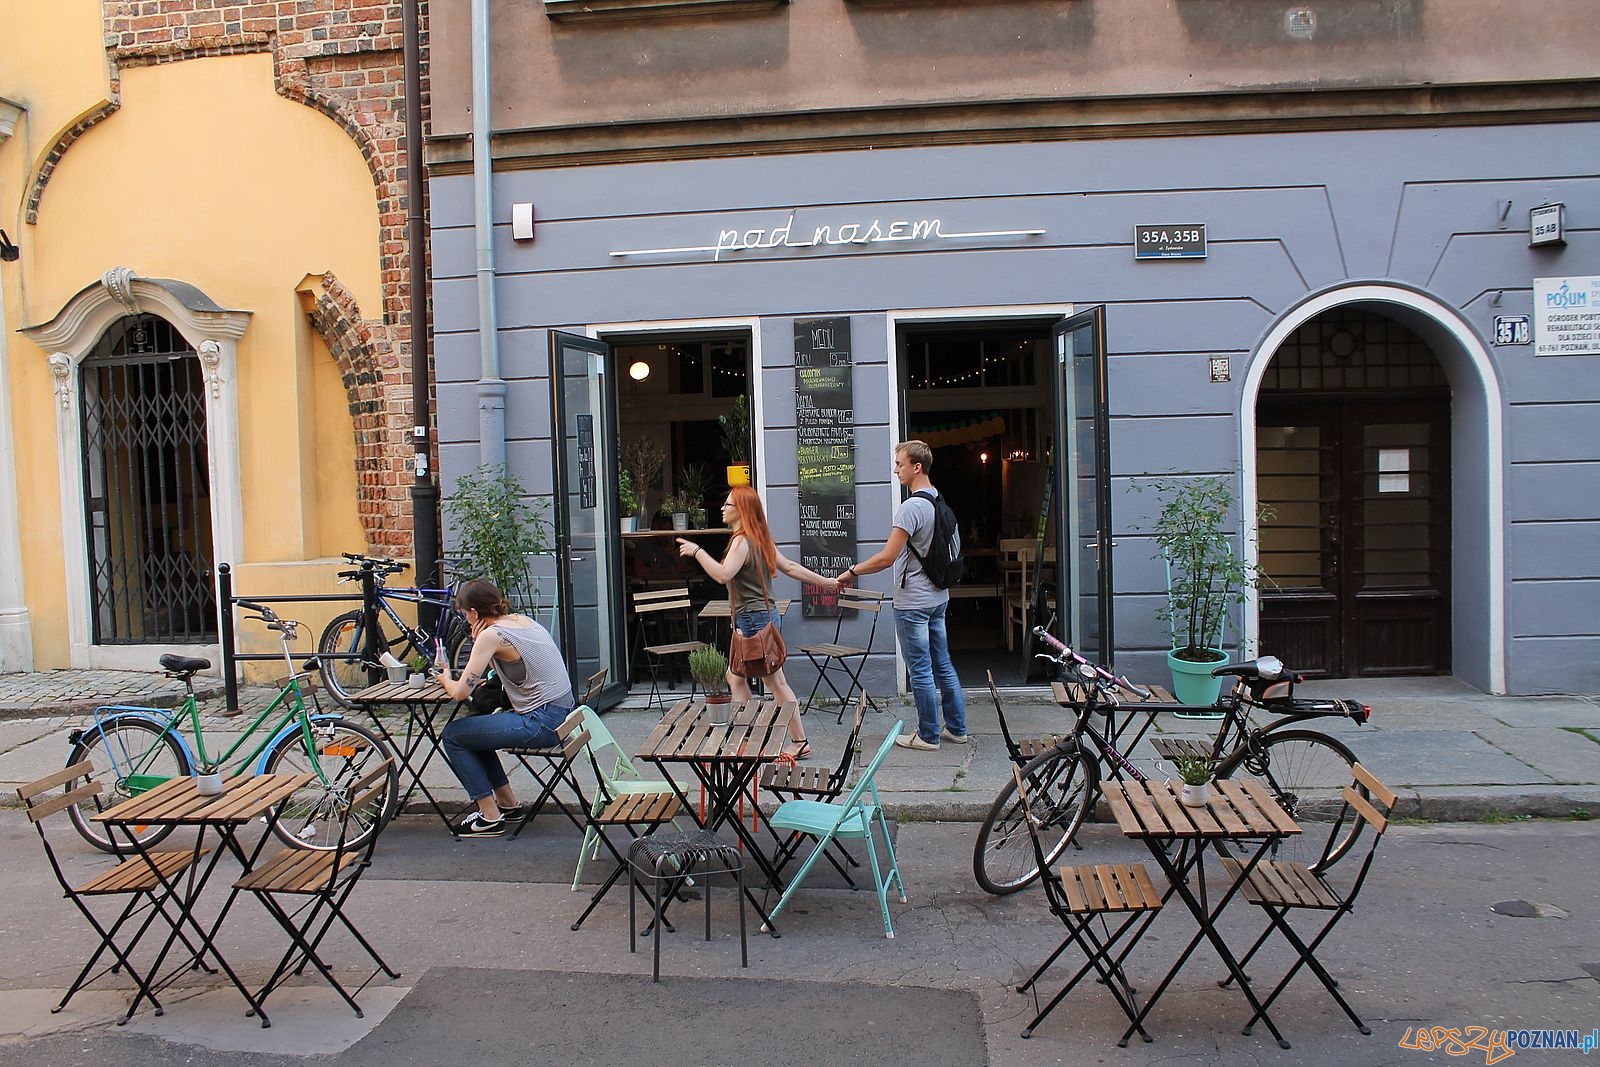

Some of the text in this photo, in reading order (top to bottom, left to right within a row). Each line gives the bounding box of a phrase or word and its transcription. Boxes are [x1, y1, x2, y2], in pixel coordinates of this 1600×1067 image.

[1535, 223, 1556, 236] 35 AB
[1498, 322, 1529, 343] 35 AB
